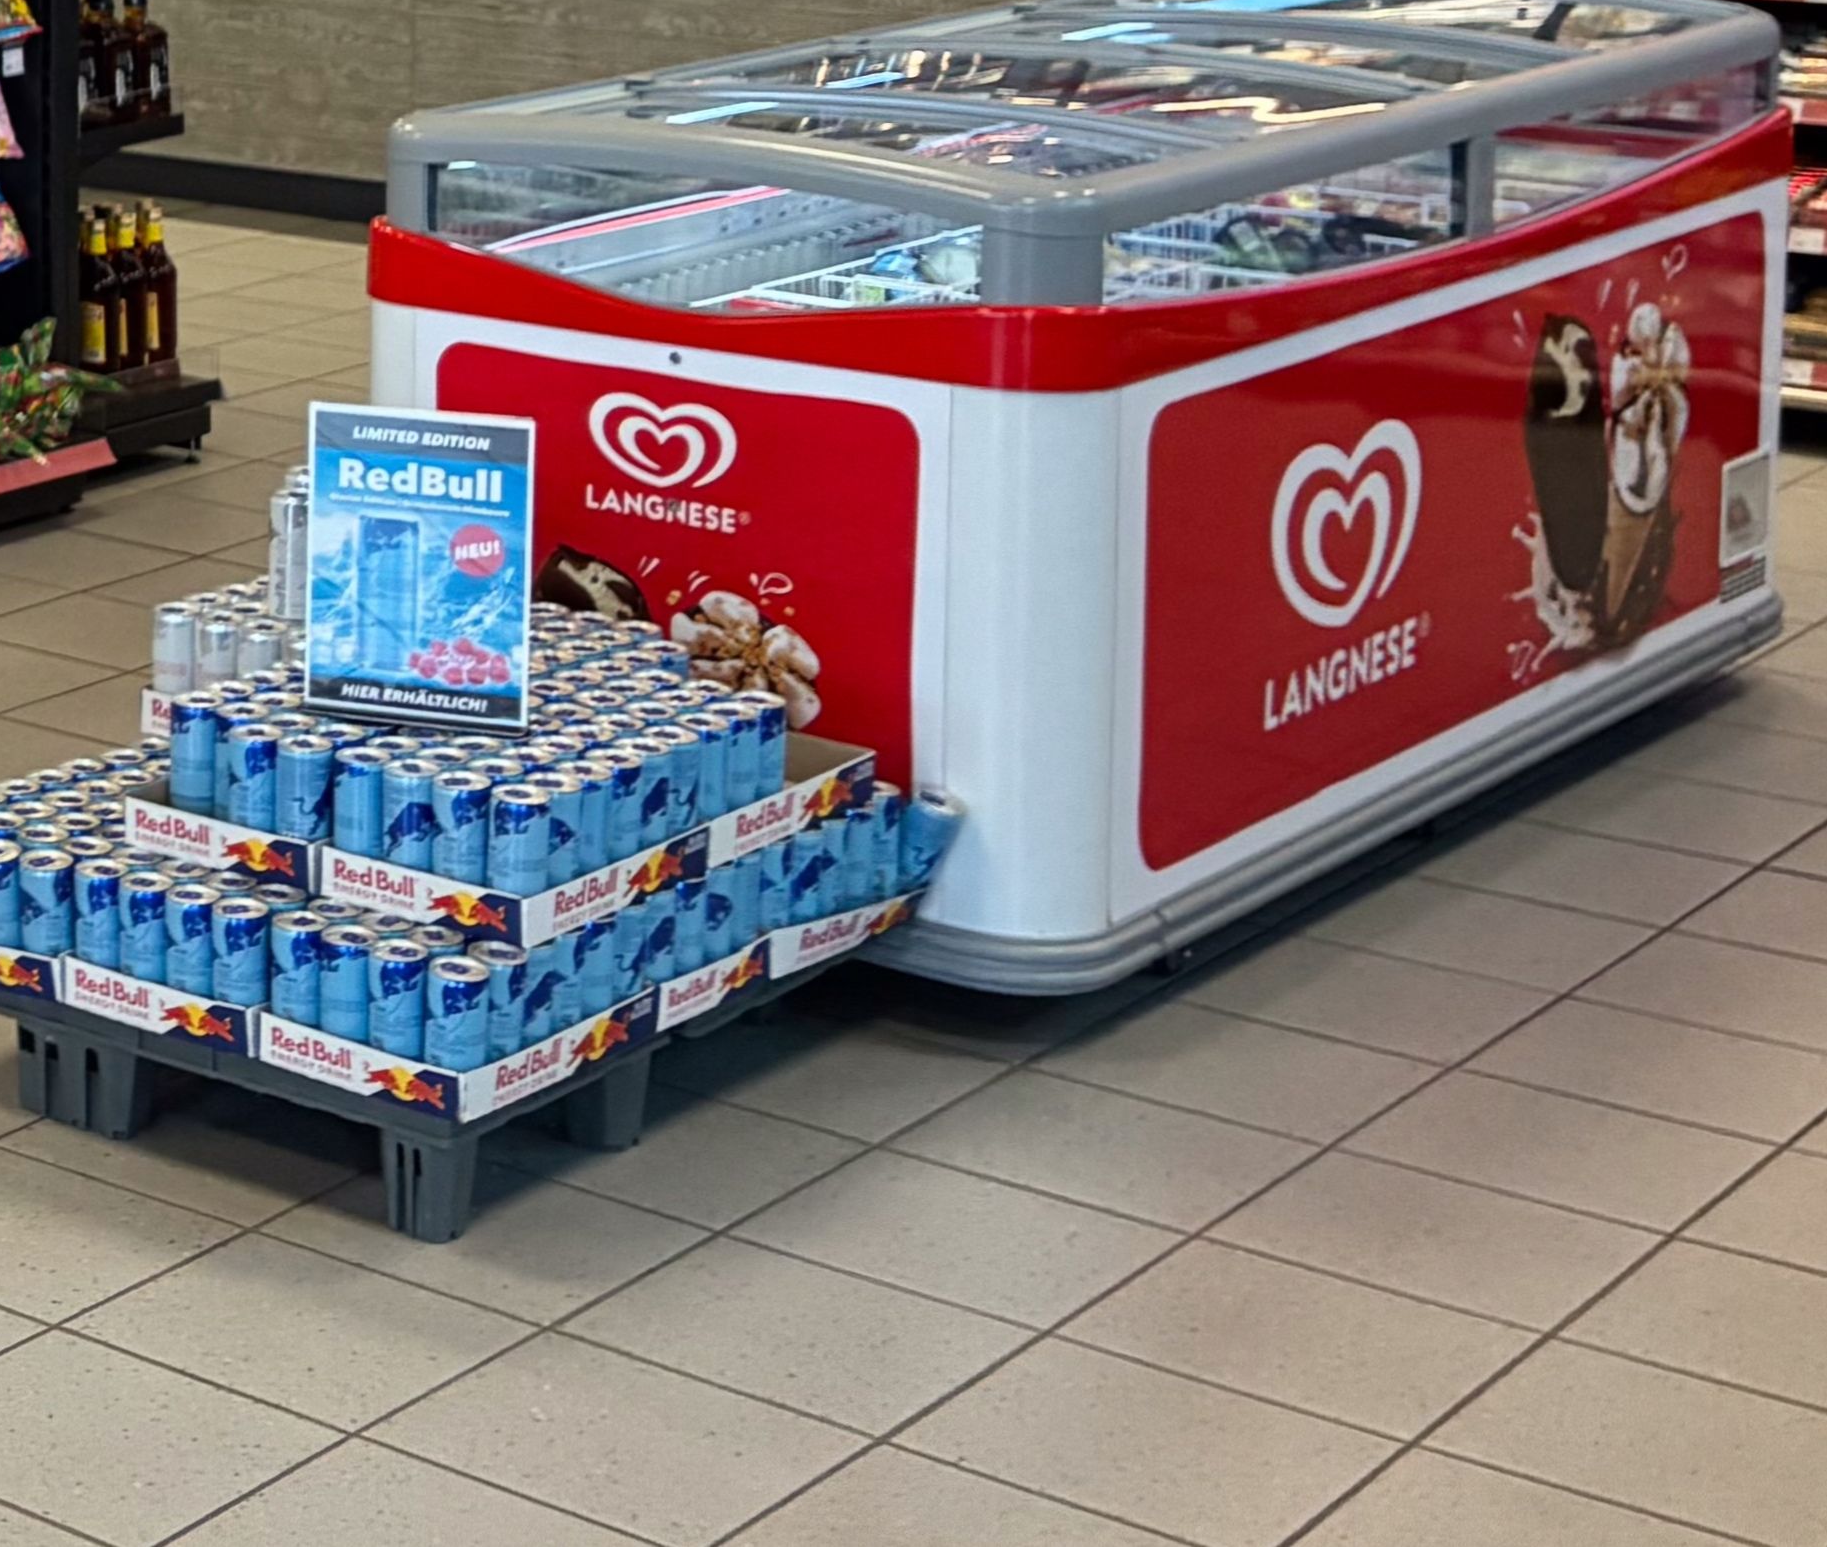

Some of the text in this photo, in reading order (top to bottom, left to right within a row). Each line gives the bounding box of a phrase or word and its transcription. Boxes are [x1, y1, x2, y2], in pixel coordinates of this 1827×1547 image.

[353, 426, 490, 451] LIMITED EDITION
[585, 483, 736, 534] LANGNESE
[455, 540, 501, 562] NEU!
[1263, 615, 1419, 731] LANGNESE
[151, 697, 172, 722] Re
[341, 683, 487, 714] HIER ERHÄLTLICH!
